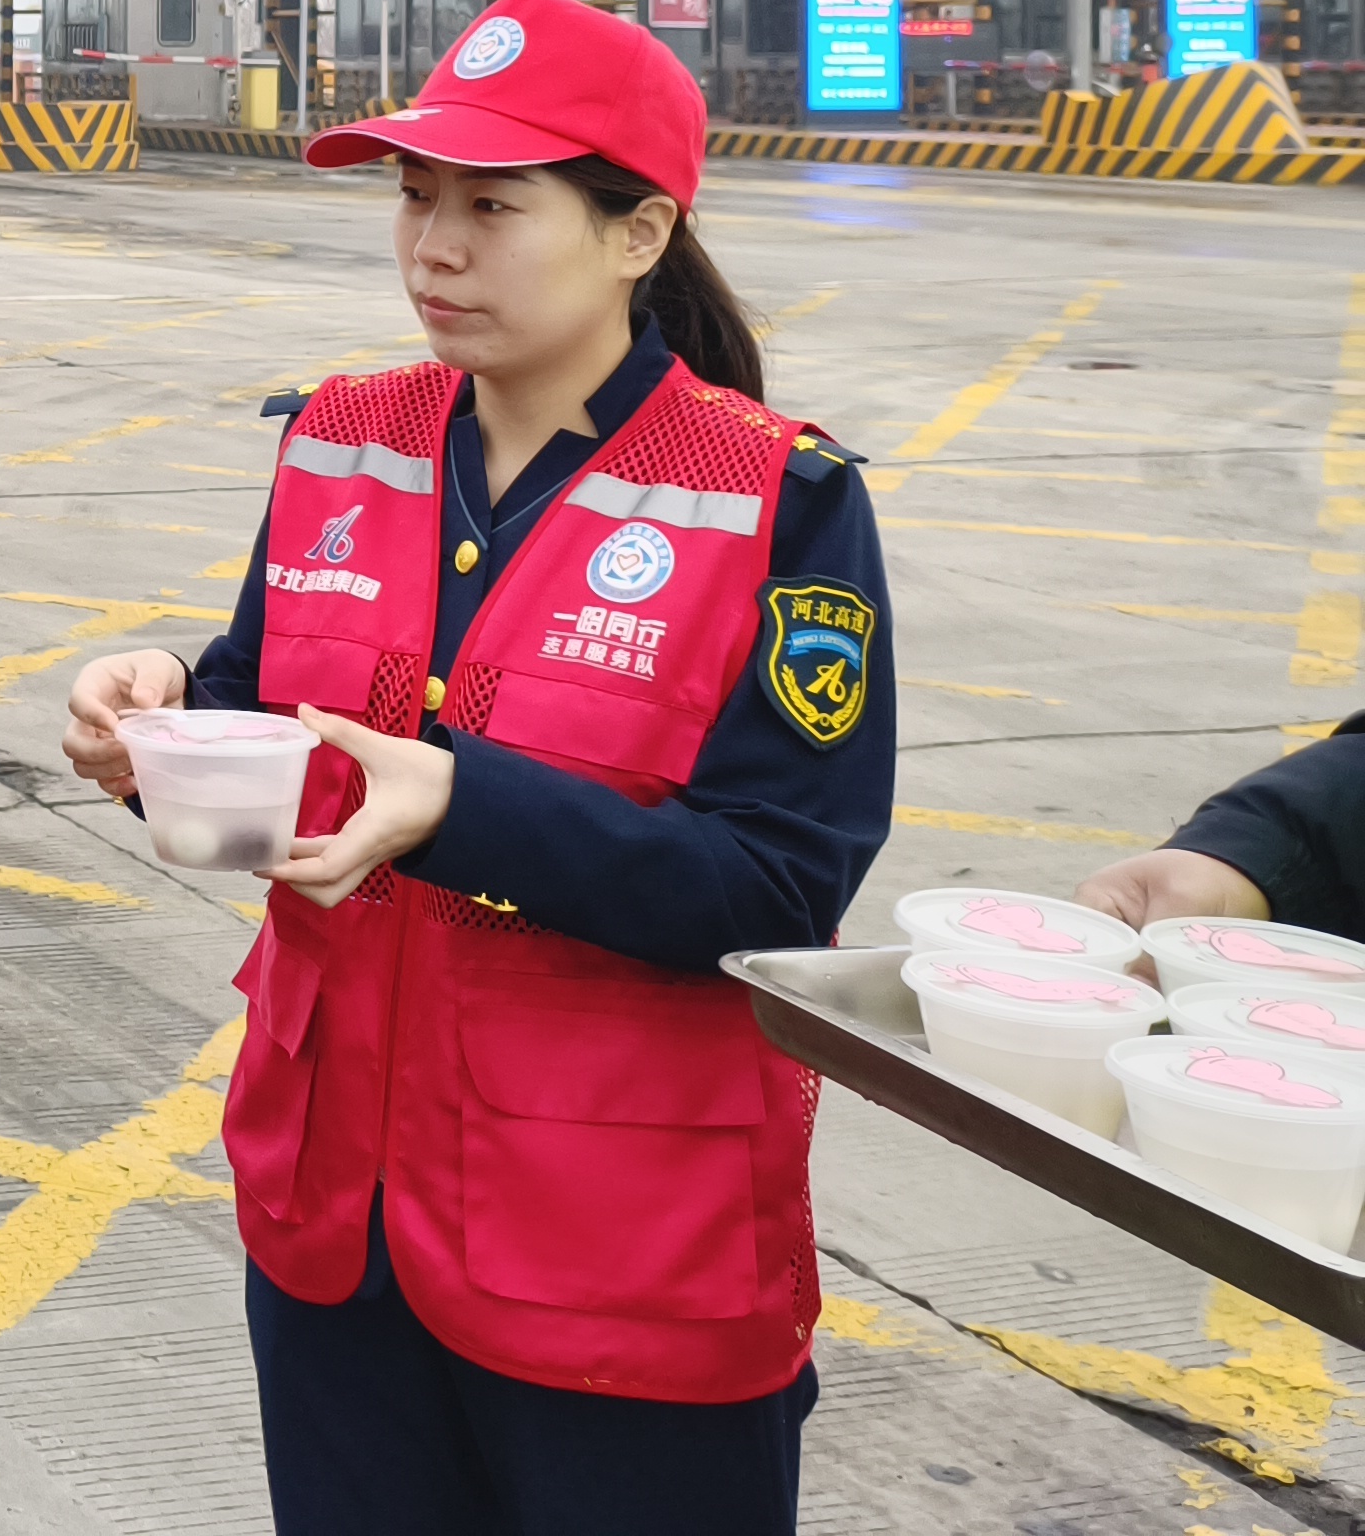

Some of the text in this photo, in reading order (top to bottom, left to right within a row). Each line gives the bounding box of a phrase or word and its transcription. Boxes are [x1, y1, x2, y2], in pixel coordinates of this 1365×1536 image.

[553, 605, 668, 649] 一路同行
[791, 596, 866, 635] 河北高速
[541, 636, 656, 677] 志愿服务队
